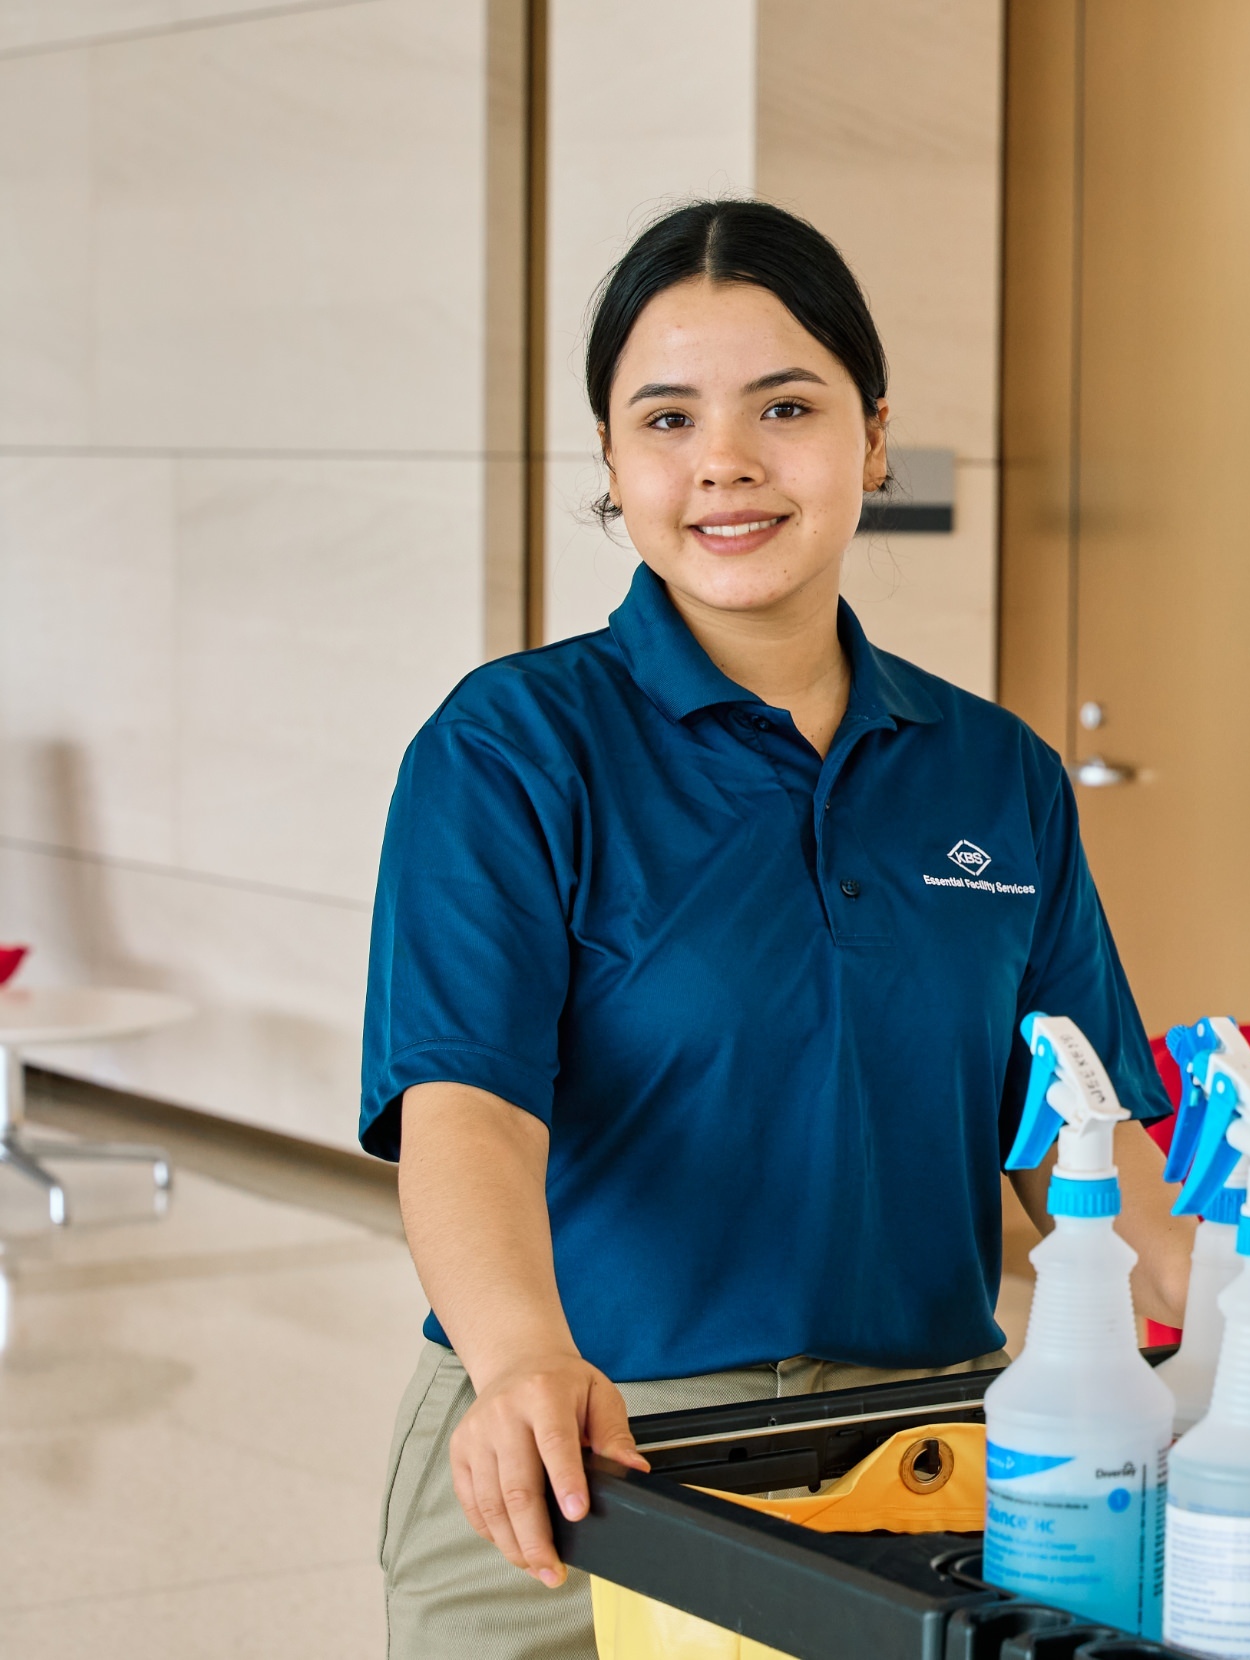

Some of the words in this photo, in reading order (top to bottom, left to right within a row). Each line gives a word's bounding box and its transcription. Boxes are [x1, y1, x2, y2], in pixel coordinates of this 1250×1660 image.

[954, 851, 984, 865] KBS
[923, 874, 965, 888] Essential
[964, 878, 996, 894] Facility
[996, 881, 1036, 895] Services
